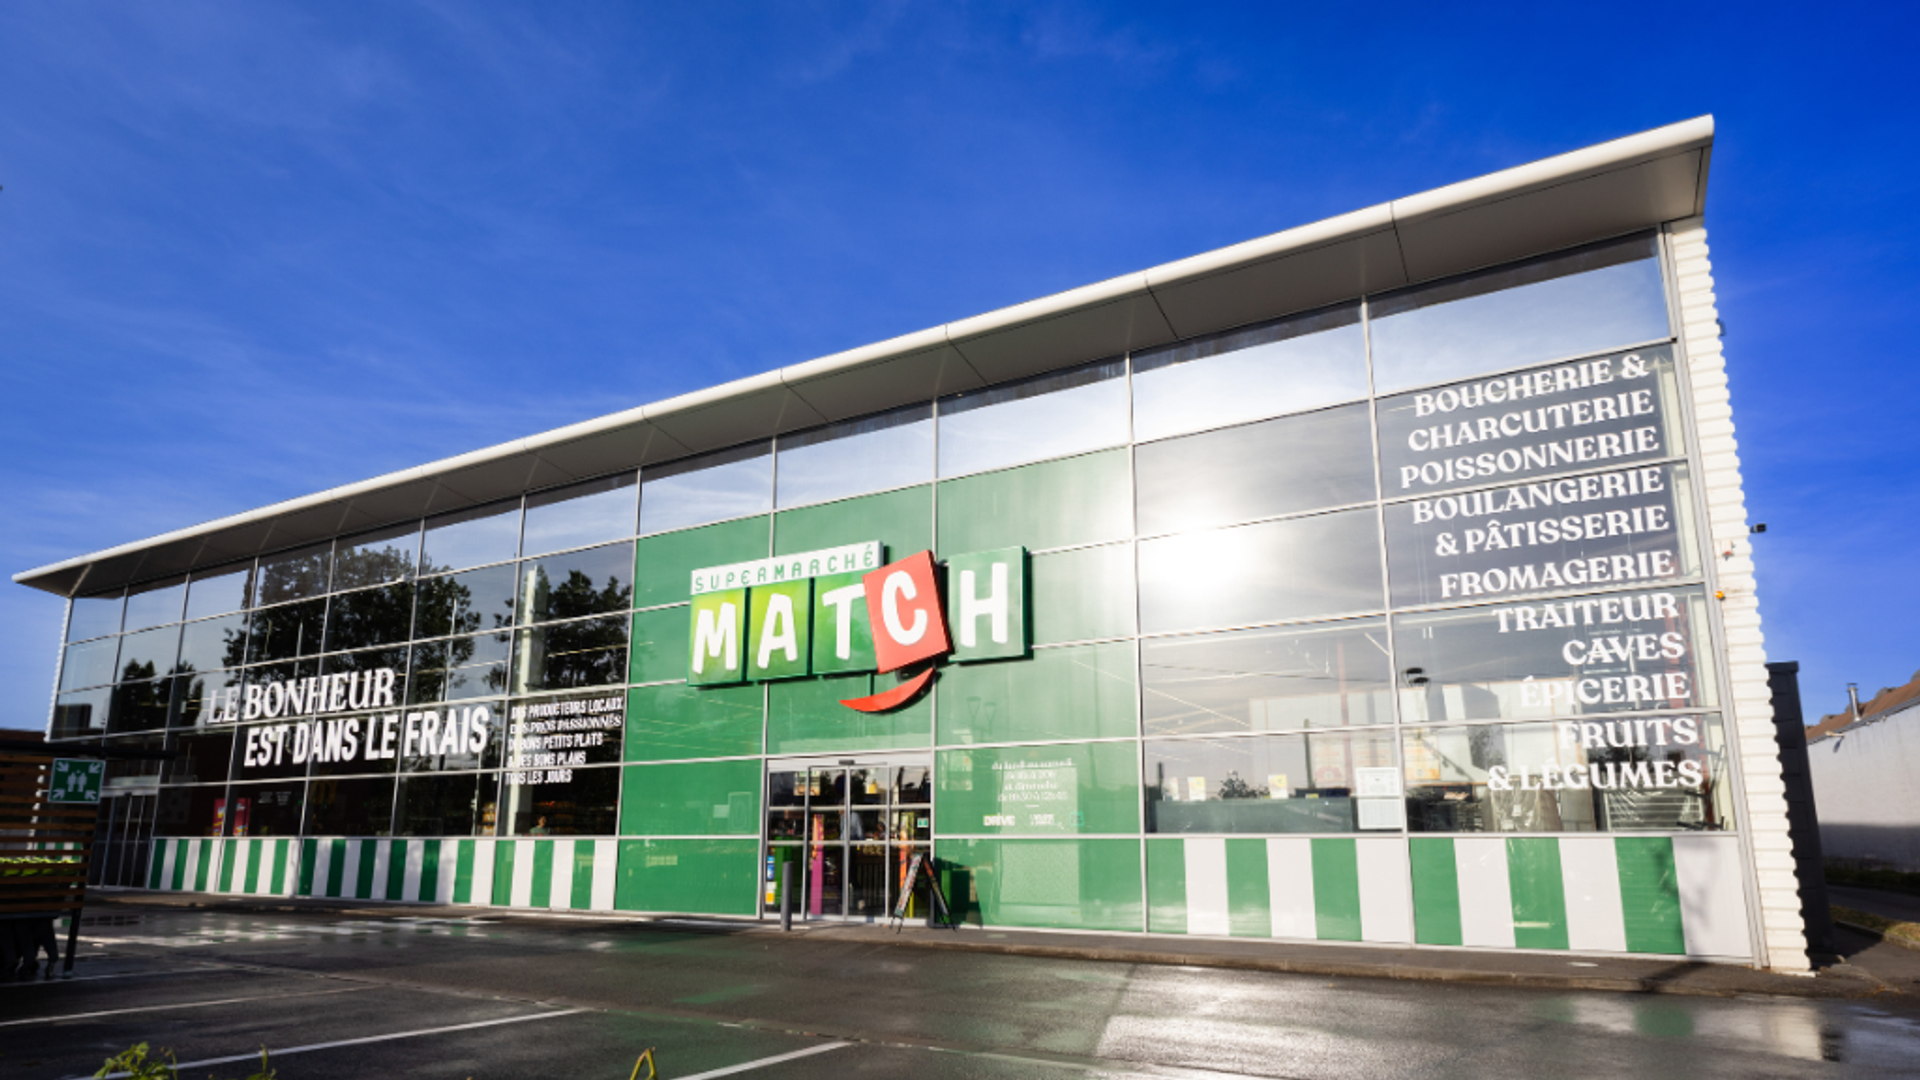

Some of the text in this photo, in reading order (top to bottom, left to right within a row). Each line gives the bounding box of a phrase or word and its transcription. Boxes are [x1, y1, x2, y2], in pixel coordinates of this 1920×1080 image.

[1415, 354, 1650, 417] BOUCHERIE &
[1408, 389, 1655, 451] CHARCUTERIE
[1400, 426, 1660, 489] POISSONNERIE
[1412, 467, 1665, 524] BOULANGERIE
[1434, 505, 1670, 556] & PÂTISSERIE
[694, 544, 875, 592] SUPERMARCHÉ
[1440, 550, 1675, 598] FROMAGERIE
[692, 562, 1009, 675] MATCH
[1492, 592, 1679, 632] TRAITEUR
[1562, 632, 1685, 666] CAVES
[207, 668, 396, 724] LE BONHEUR
[528, 699, 587, 716] PRODUCTEURS
[588, 696, 623, 712] LOCAUX
[1520, 672, 1691, 708] ÉPICERIE
[244, 707, 489, 767] EST DANS LE FRAIS
[531, 719, 556, 733] PROS
[543, 734, 573, 749] PETITS
[574, 732, 603, 748] PLATS
[1559, 718, 1699, 749] FRUITS
[505, 768, 573, 785] TOUS LES JOURS
[534, 752, 556, 766] BONS
[557, 750, 586, 766] PLANS
[1487, 758, 1703, 791] & LÉGUMES
